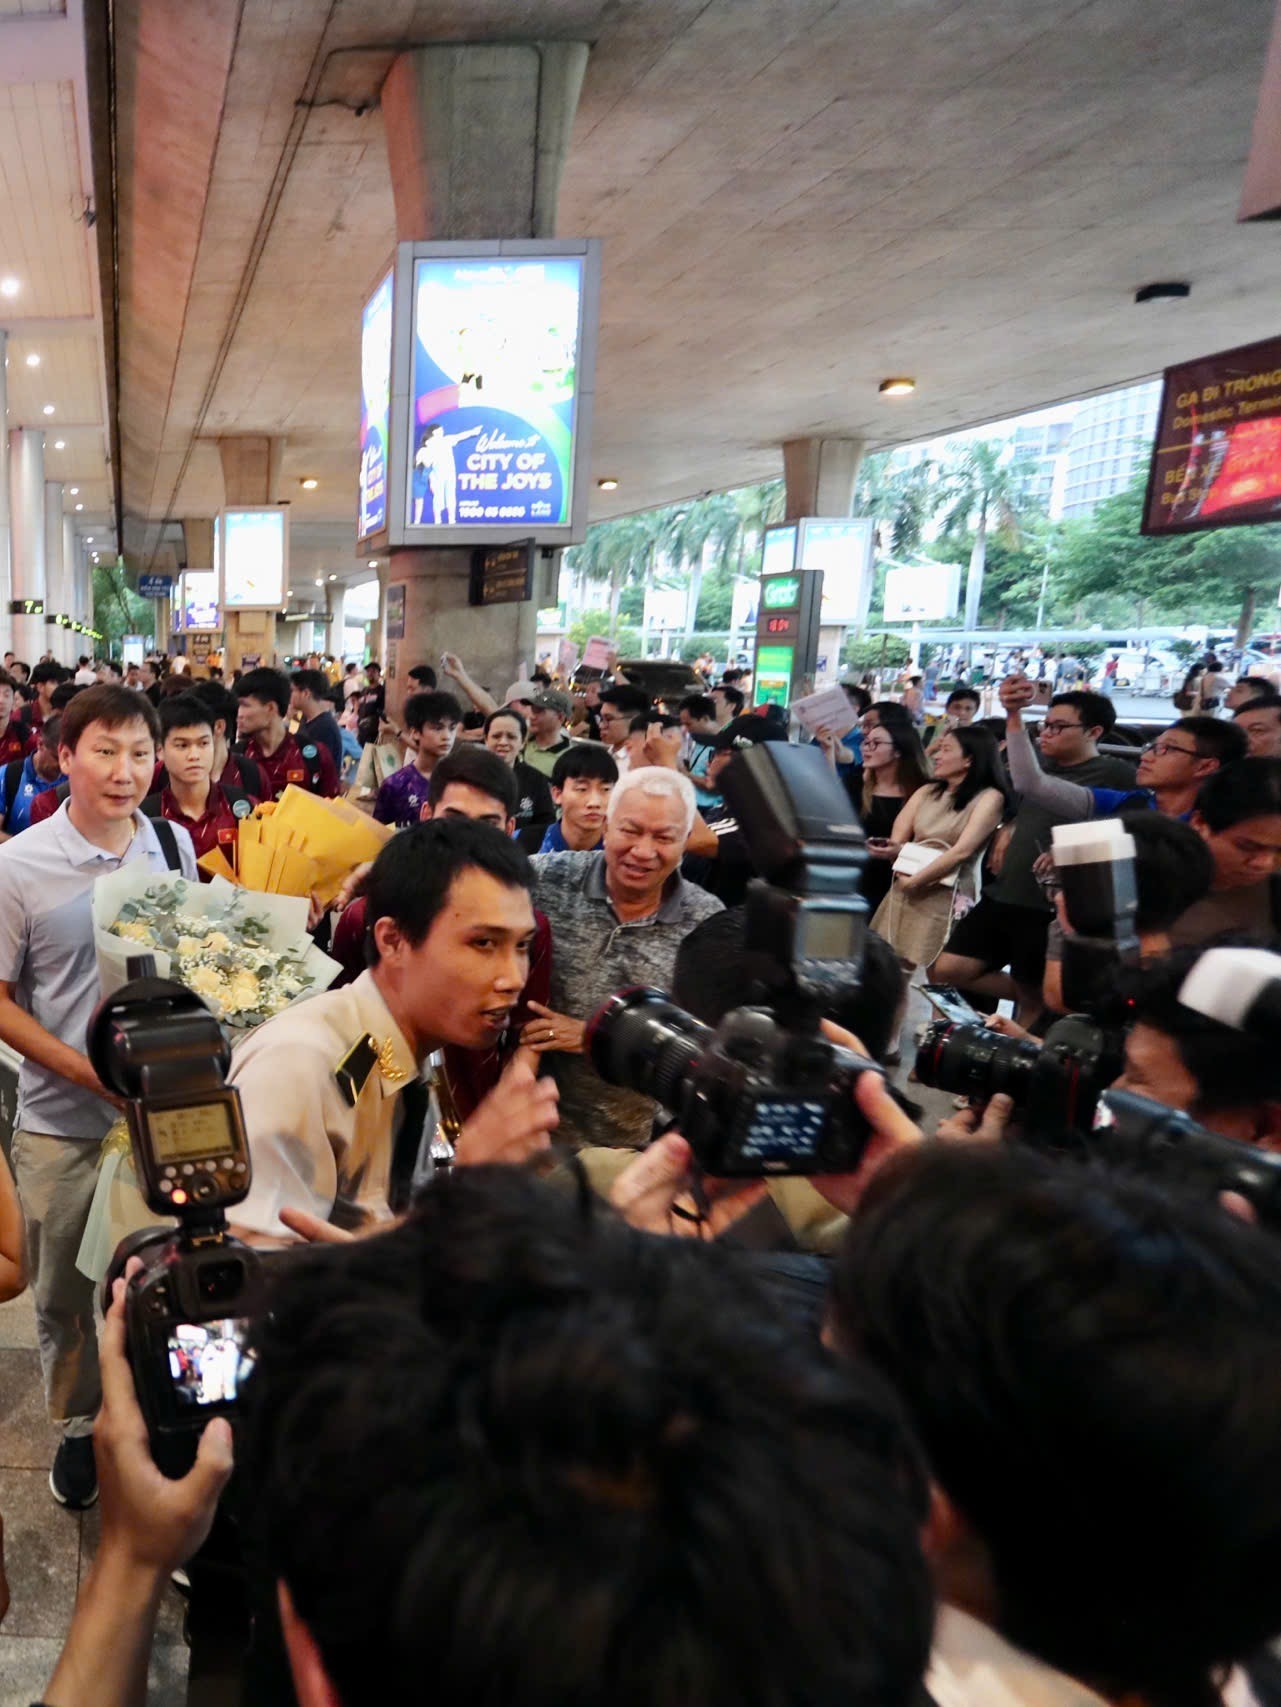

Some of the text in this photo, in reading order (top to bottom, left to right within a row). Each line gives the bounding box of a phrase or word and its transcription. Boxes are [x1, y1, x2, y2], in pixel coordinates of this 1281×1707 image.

[1176, 391, 1199, 409] GA
[1173, 406, 1234, 430] Domestic
[466, 453, 546, 471] CITY OF
[458, 473, 552, 490] THE JOYS
[765, 581, 800, 605] Grab
[24, 600, 34, 613] 7
